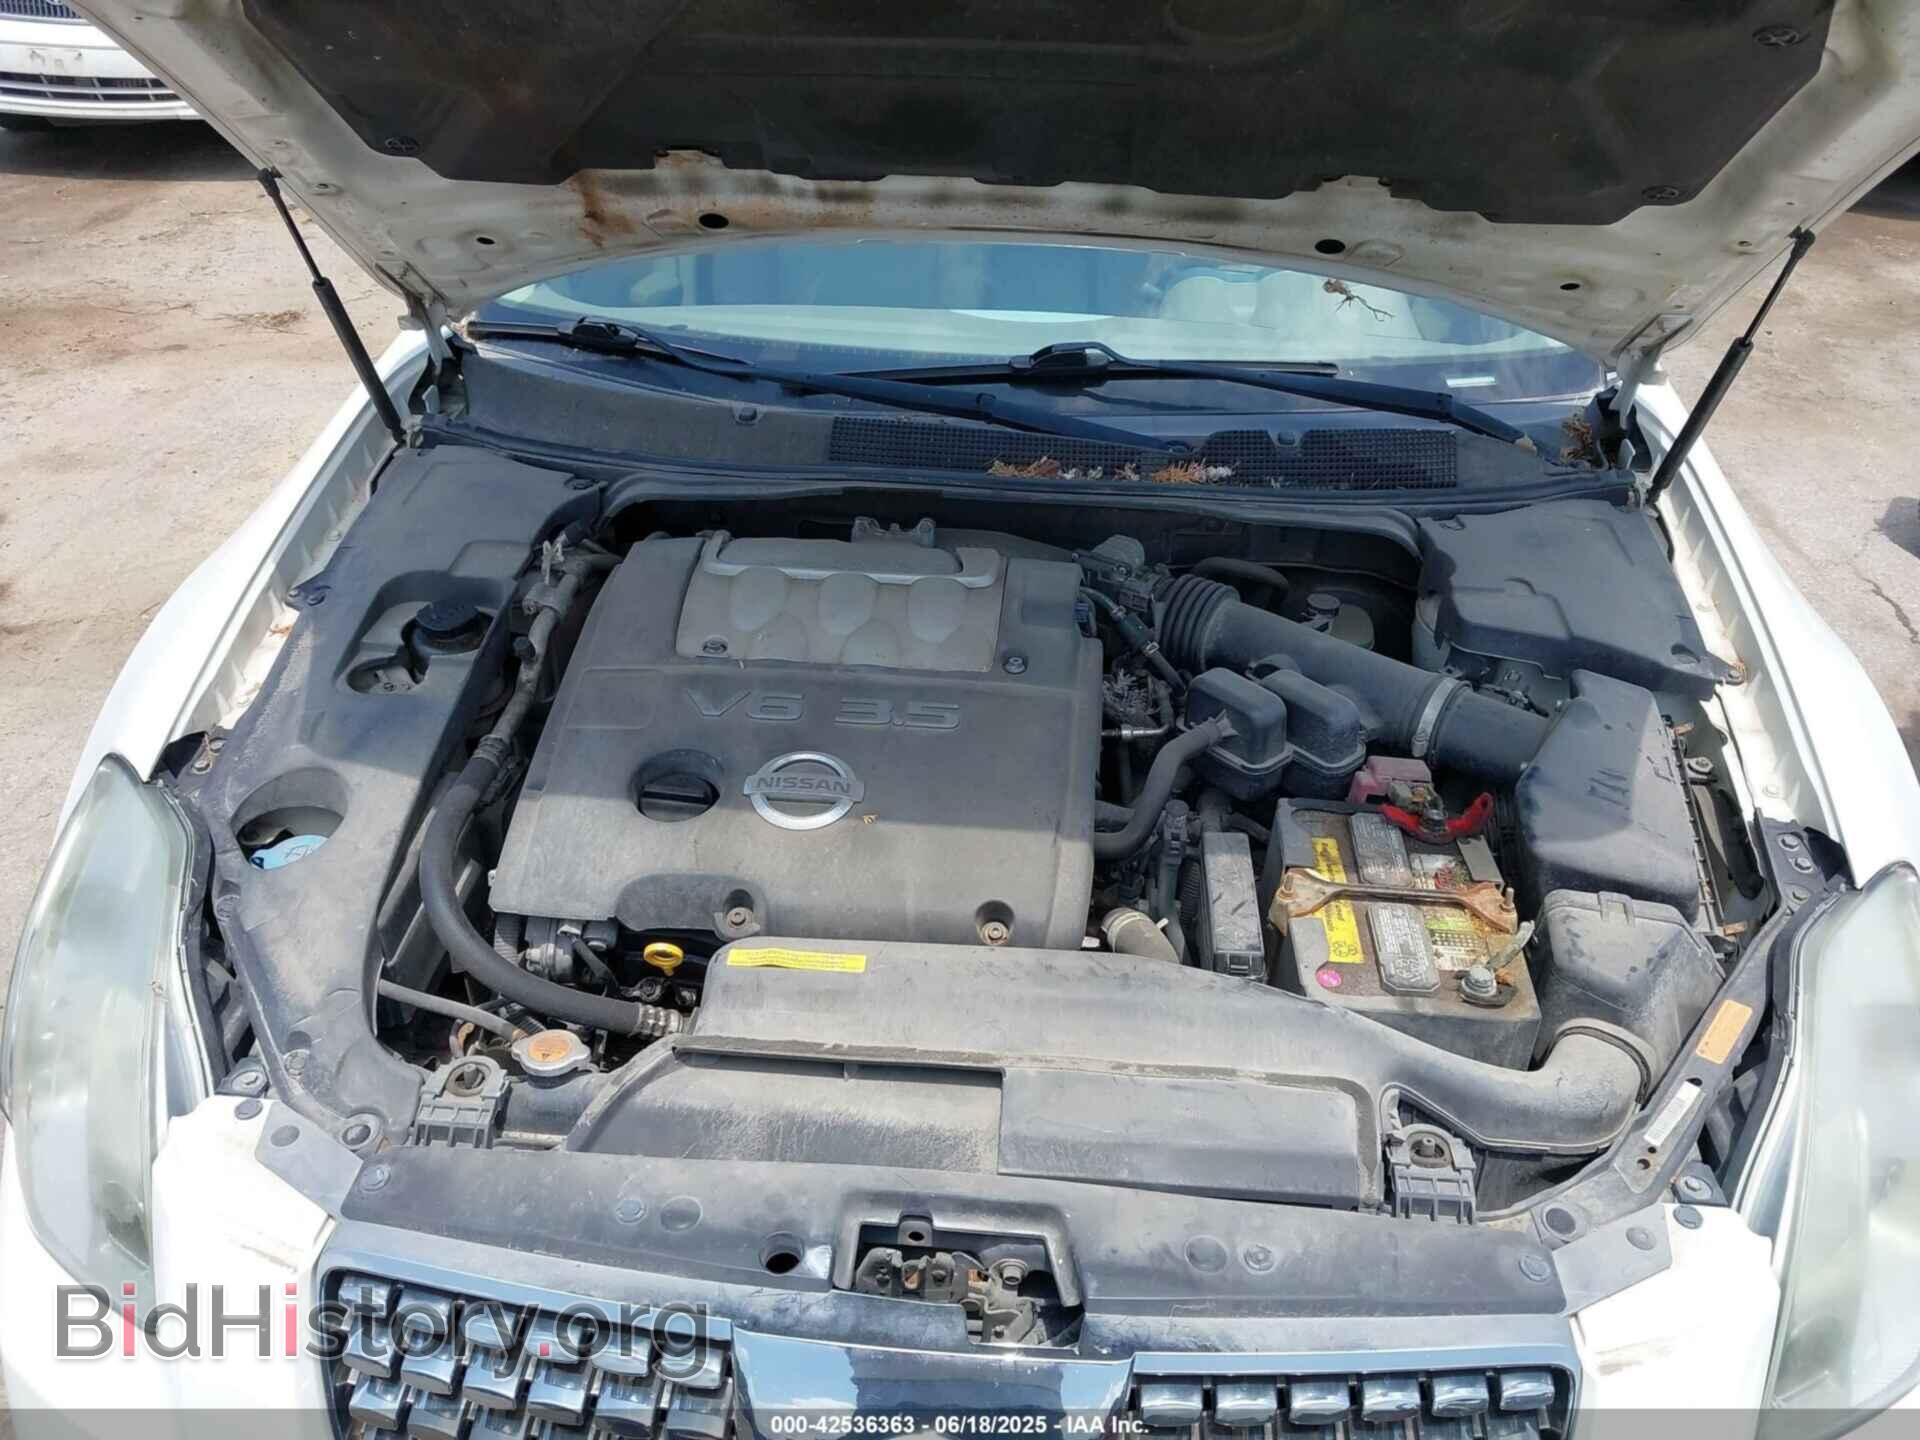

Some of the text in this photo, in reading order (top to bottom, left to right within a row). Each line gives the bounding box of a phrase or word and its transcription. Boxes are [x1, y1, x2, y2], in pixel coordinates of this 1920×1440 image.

[687, 687, 961, 730] V6 3.5
[754, 775, 851, 795] NISSAN
